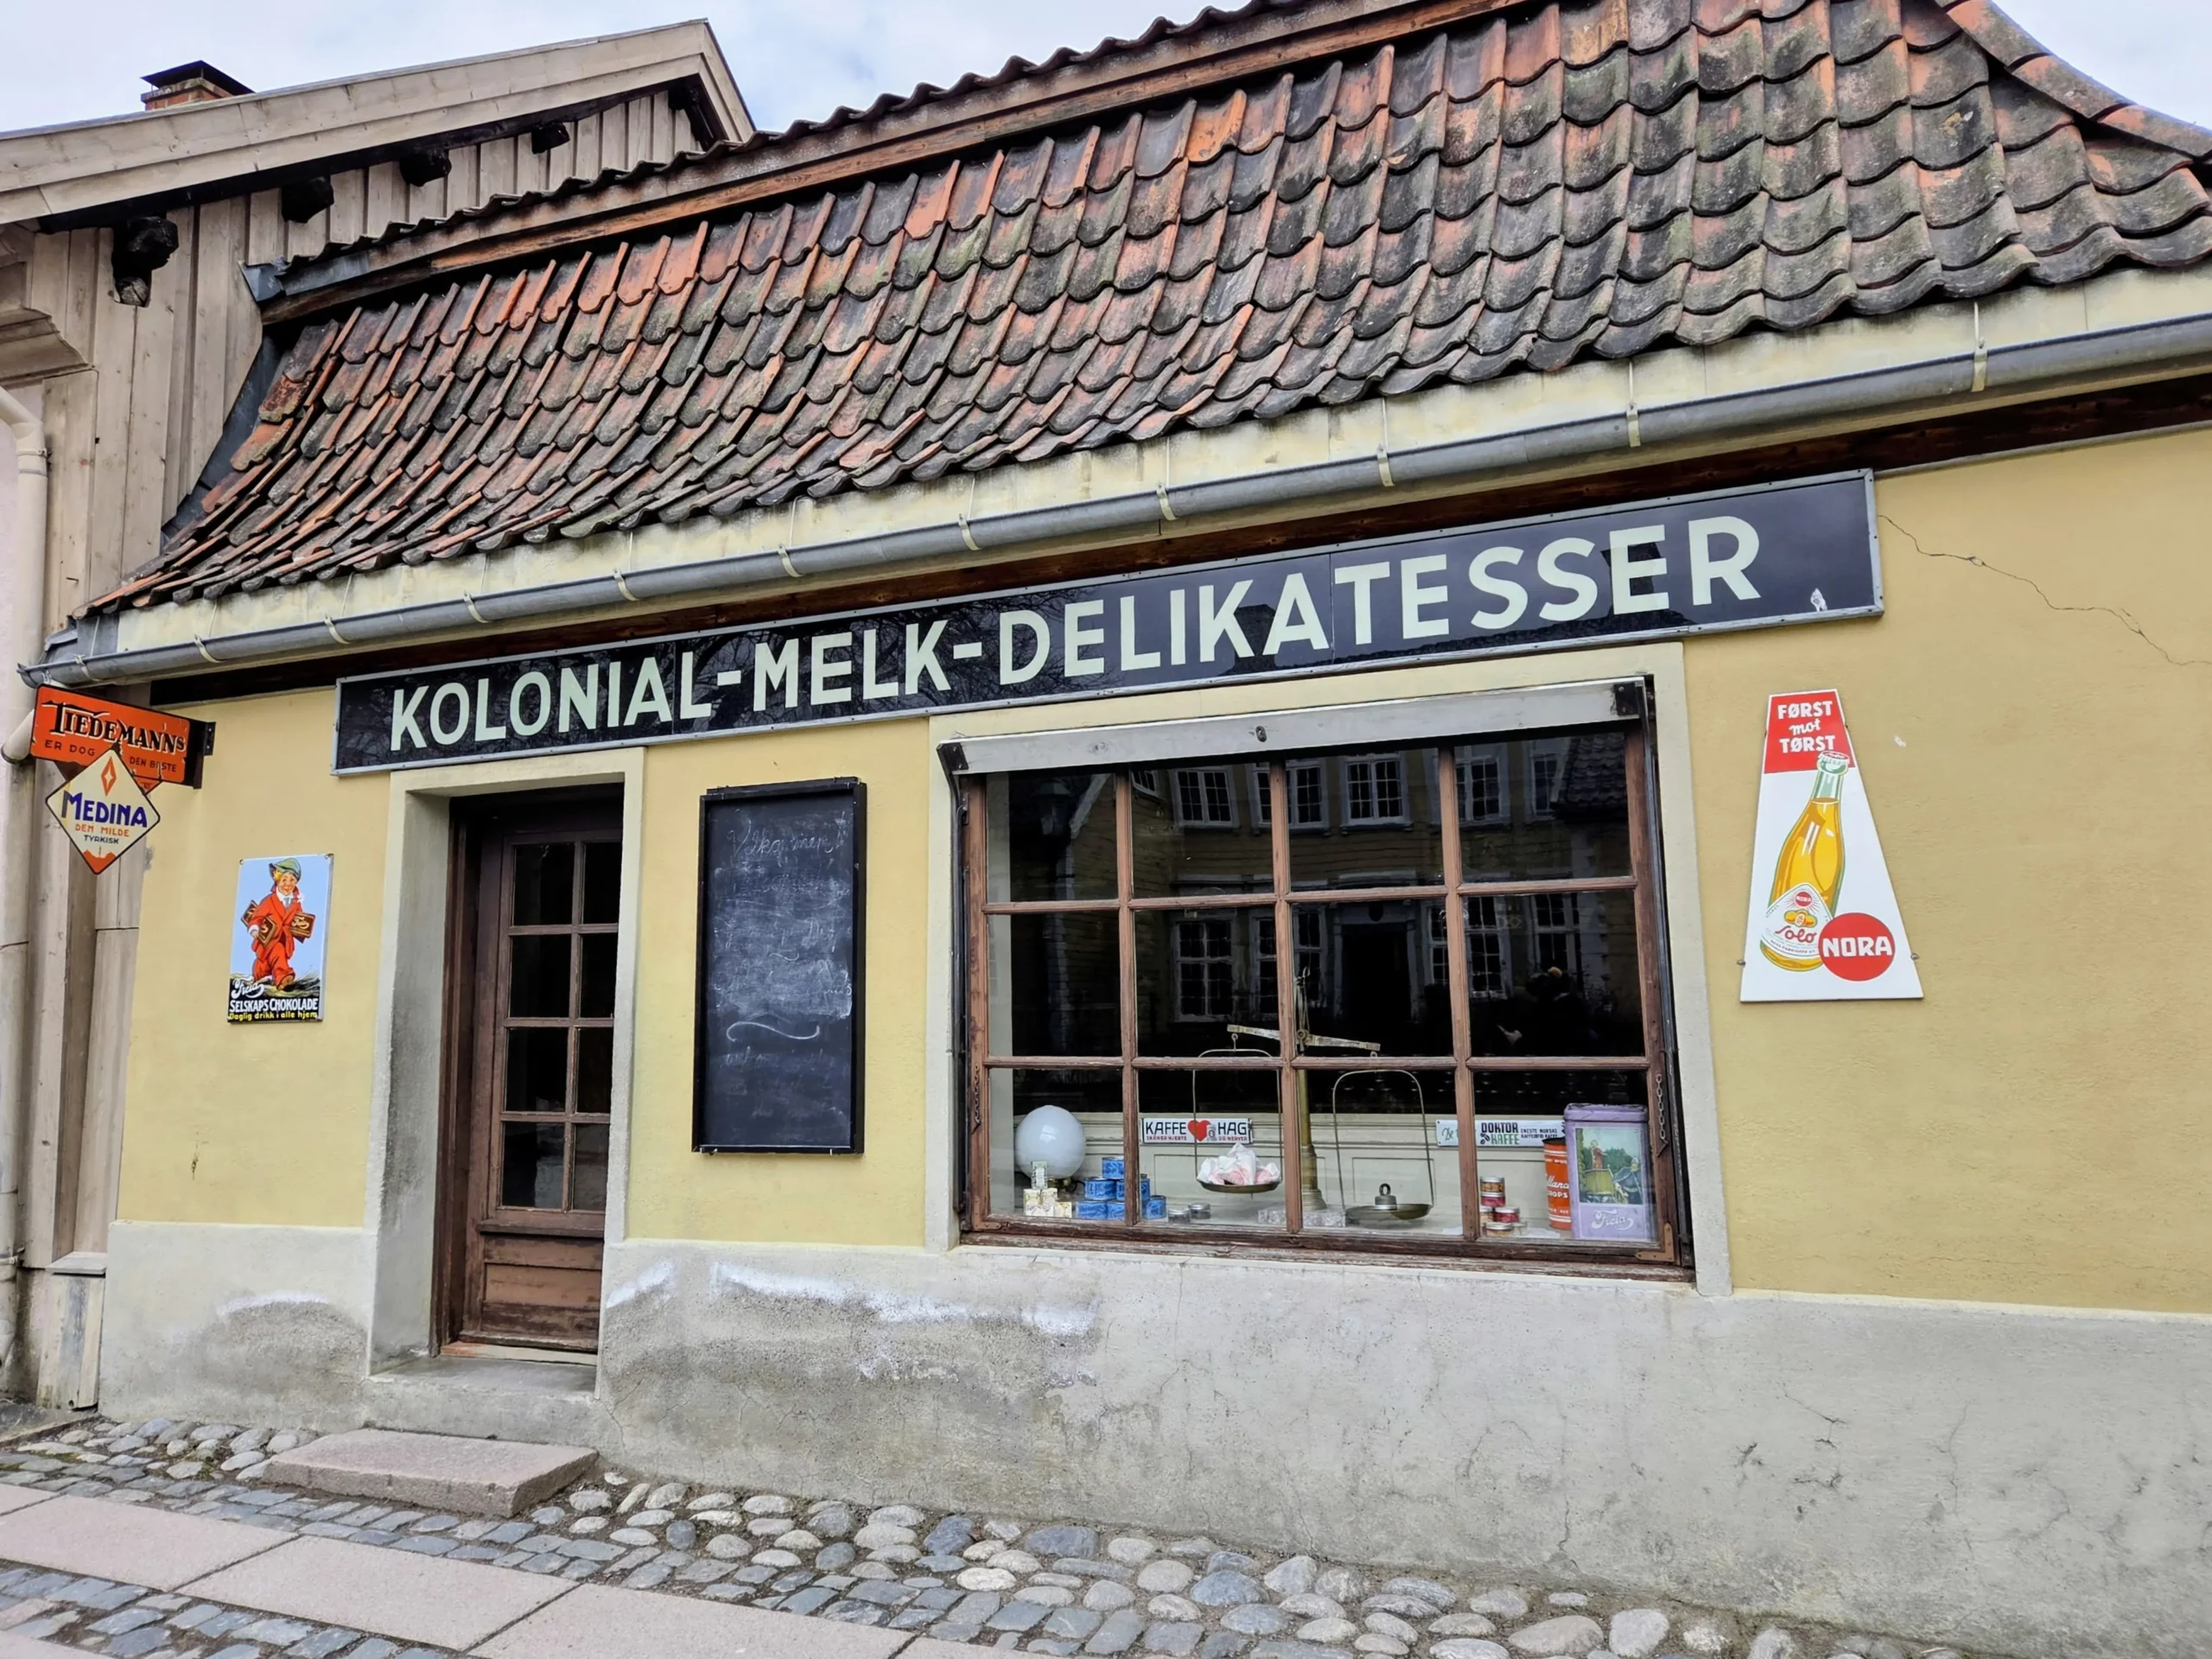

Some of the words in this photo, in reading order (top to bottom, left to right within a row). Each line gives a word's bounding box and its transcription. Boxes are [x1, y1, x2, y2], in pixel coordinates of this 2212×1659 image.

[1777, 701, 1833, 719] FØRST
[41, 700, 187, 754] TIEDEMANNS
[1789, 718, 1821, 735] mot
[1779, 734, 1835, 753] TØRST
[45, 739, 61, 750] ER
[69, 744, 96, 757] DOG
[130, 756, 147, 767] DEN
[61, 790, 148, 828] MEDINA
[75, 823, 94, 833] DEN
[100, 826, 130, 837] MILDE
[84, 835, 119, 844] TYRKISK
[1775, 925, 1817, 944] Solo
[1822, 936, 1893, 957] NORA
[231, 976, 265, 999] Freia
[229, 1000, 270, 1013] SELSKAPS
[270, 998, 319, 1011] CHOKOLADE
[229, 1012, 252, 1021] Daglig
[1146, 1122, 1186, 1135] KAFFE
[1217, 1122, 1247, 1135] HAG
[1481, 1122, 1519, 1134] DOKTOR
[1491, 1133, 1520, 1145] KAFFE
